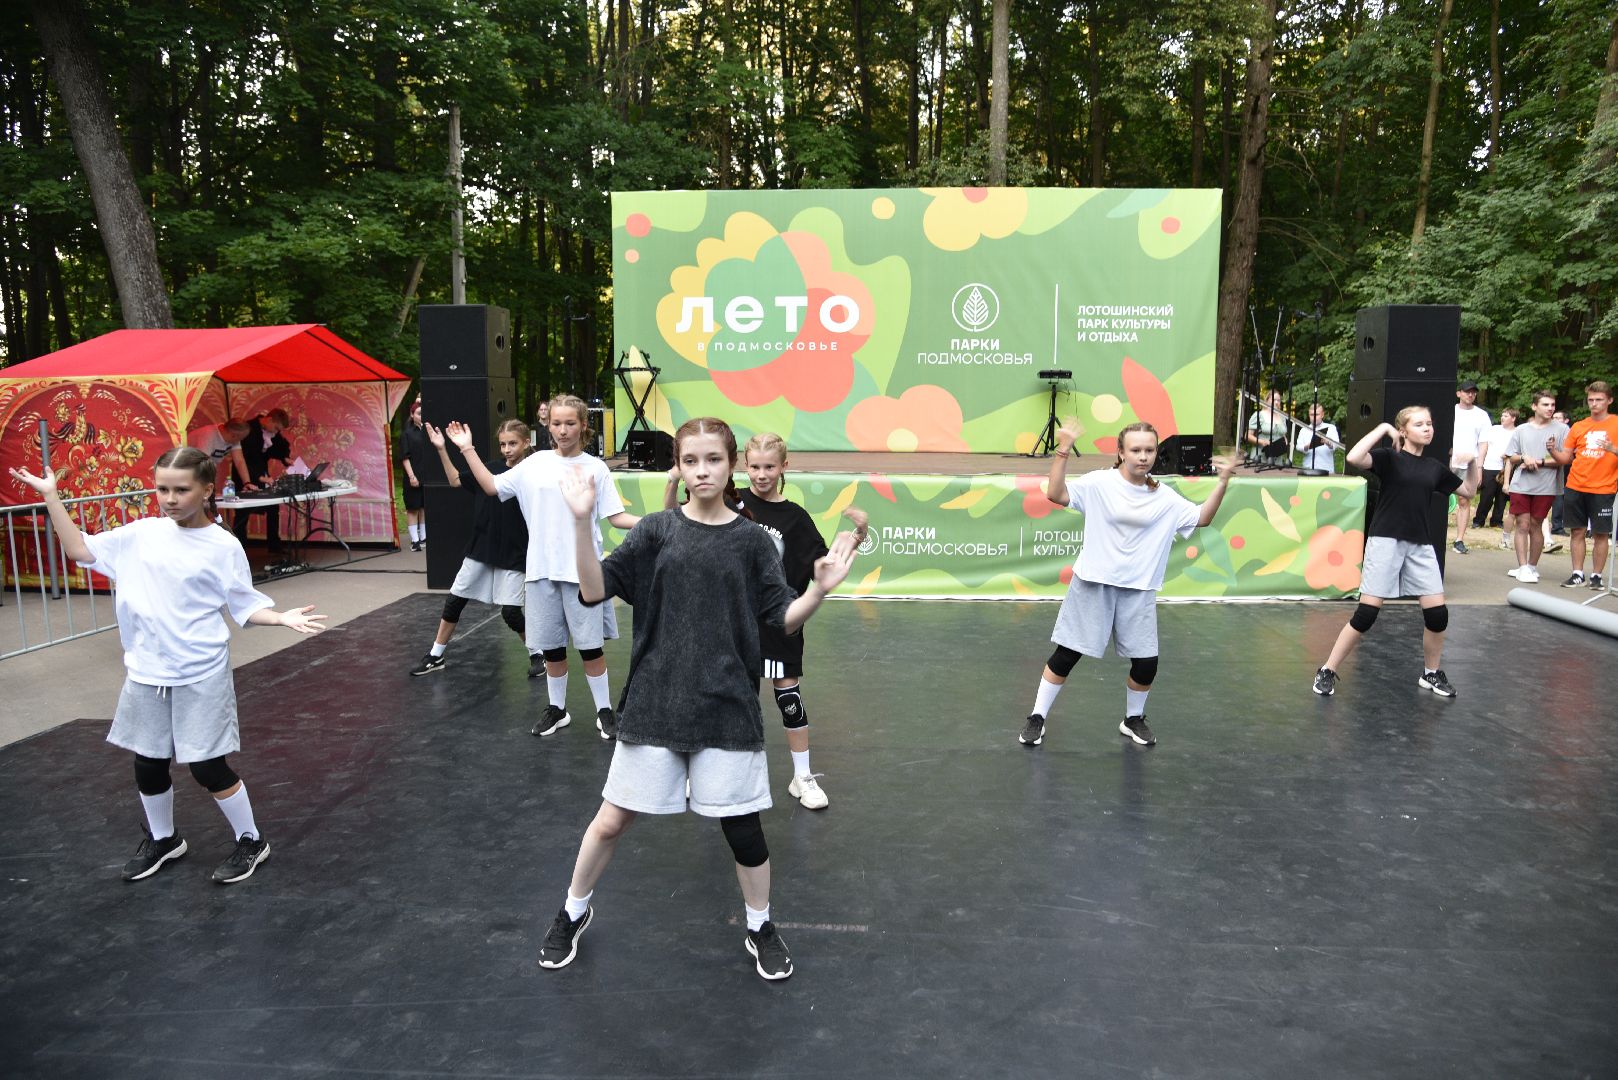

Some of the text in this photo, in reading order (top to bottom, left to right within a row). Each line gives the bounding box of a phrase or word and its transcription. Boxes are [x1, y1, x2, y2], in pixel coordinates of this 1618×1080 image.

[1077, 304, 1174, 316] ЛОТОШИНСКИЙ
[1077, 319, 1171, 330] ПАРК КУЛЬТУРЫ
[1077, 332, 1138, 343] И ОТДЫХА
[714, 341, 838, 352] ПОДМОСКОВЬЕ
[950, 338, 1000, 351] ПАРКИ
[917, 352, 1033, 365] ПОДМОСКОВЬЯ
[882, 527, 936, 540] ПАРКИ
[1033, 530, 1083, 542] ЛОТОШ
[882, 542, 1008, 556] ПОДМОСКОВЬЯ
